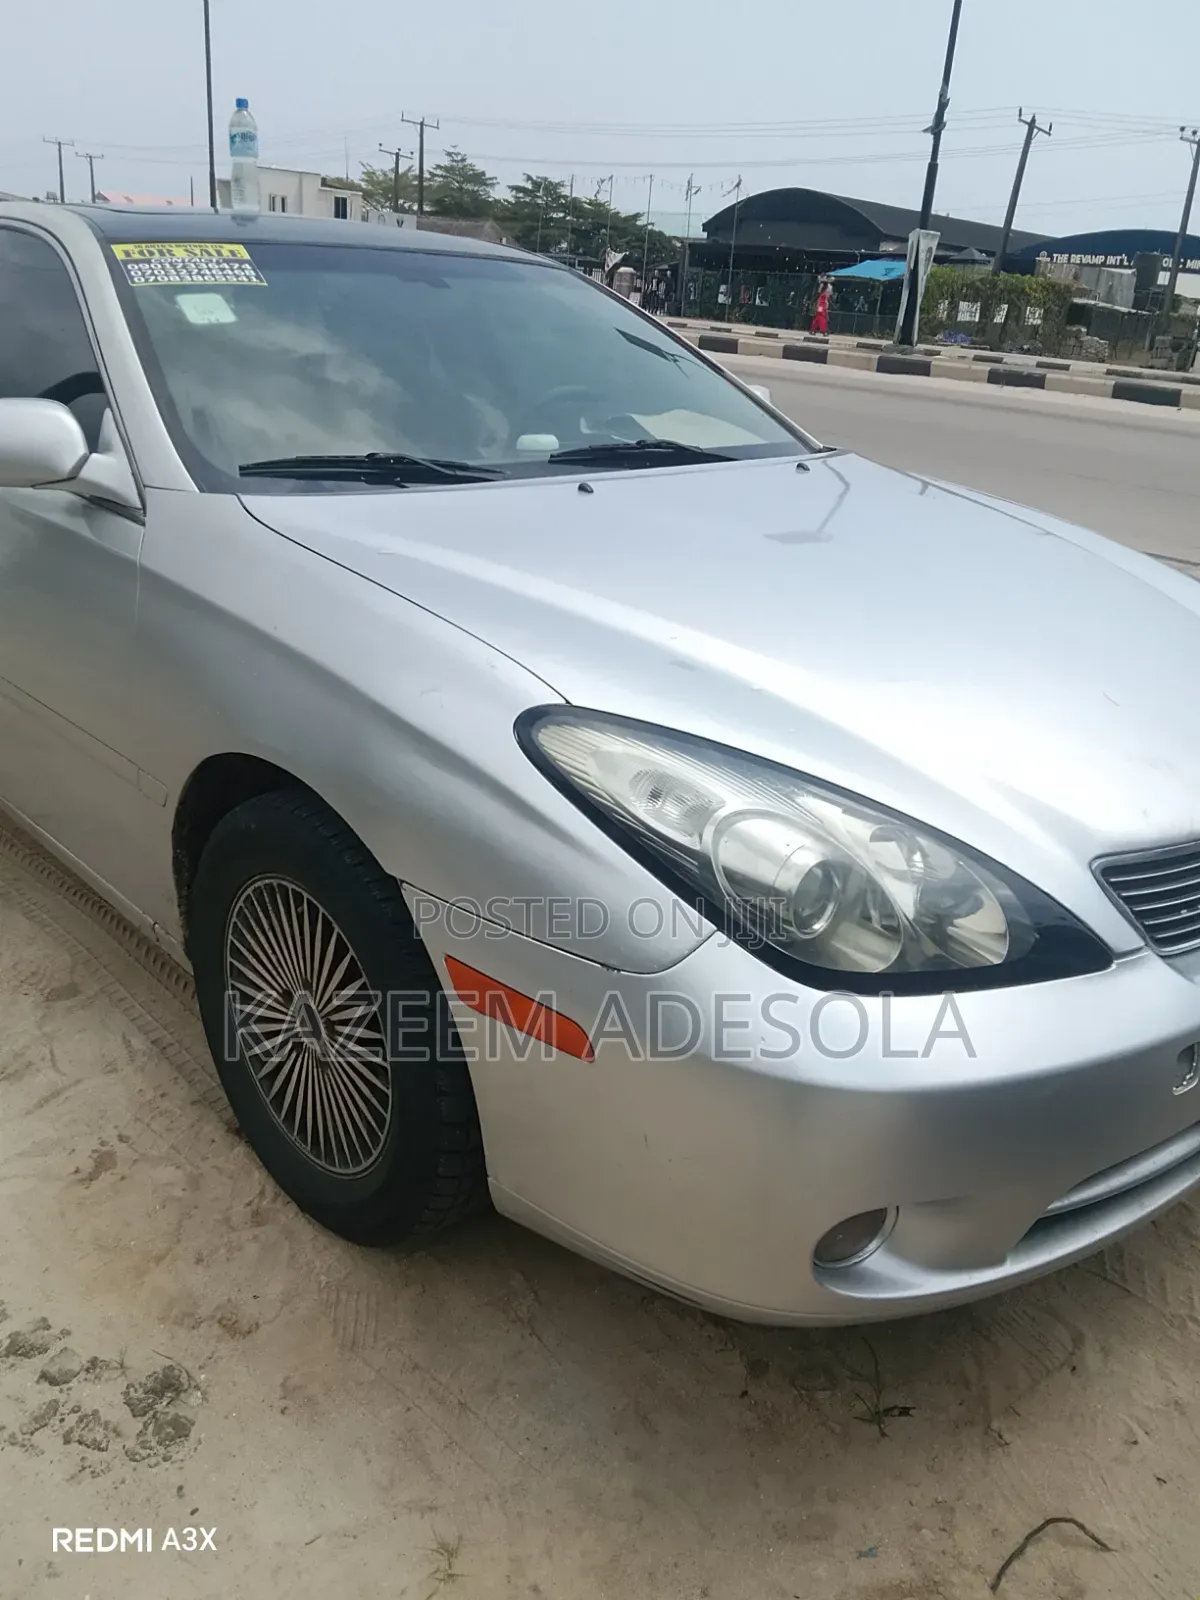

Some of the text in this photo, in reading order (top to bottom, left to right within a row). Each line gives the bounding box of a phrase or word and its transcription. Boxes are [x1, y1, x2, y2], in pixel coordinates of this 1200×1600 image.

[122, 248, 244, 258] FOR SALE
[1053, 253, 1069, 264] THE
[1070, 254, 1105, 265] REVAMP
[1106, 253, 1129, 266] INT'L
